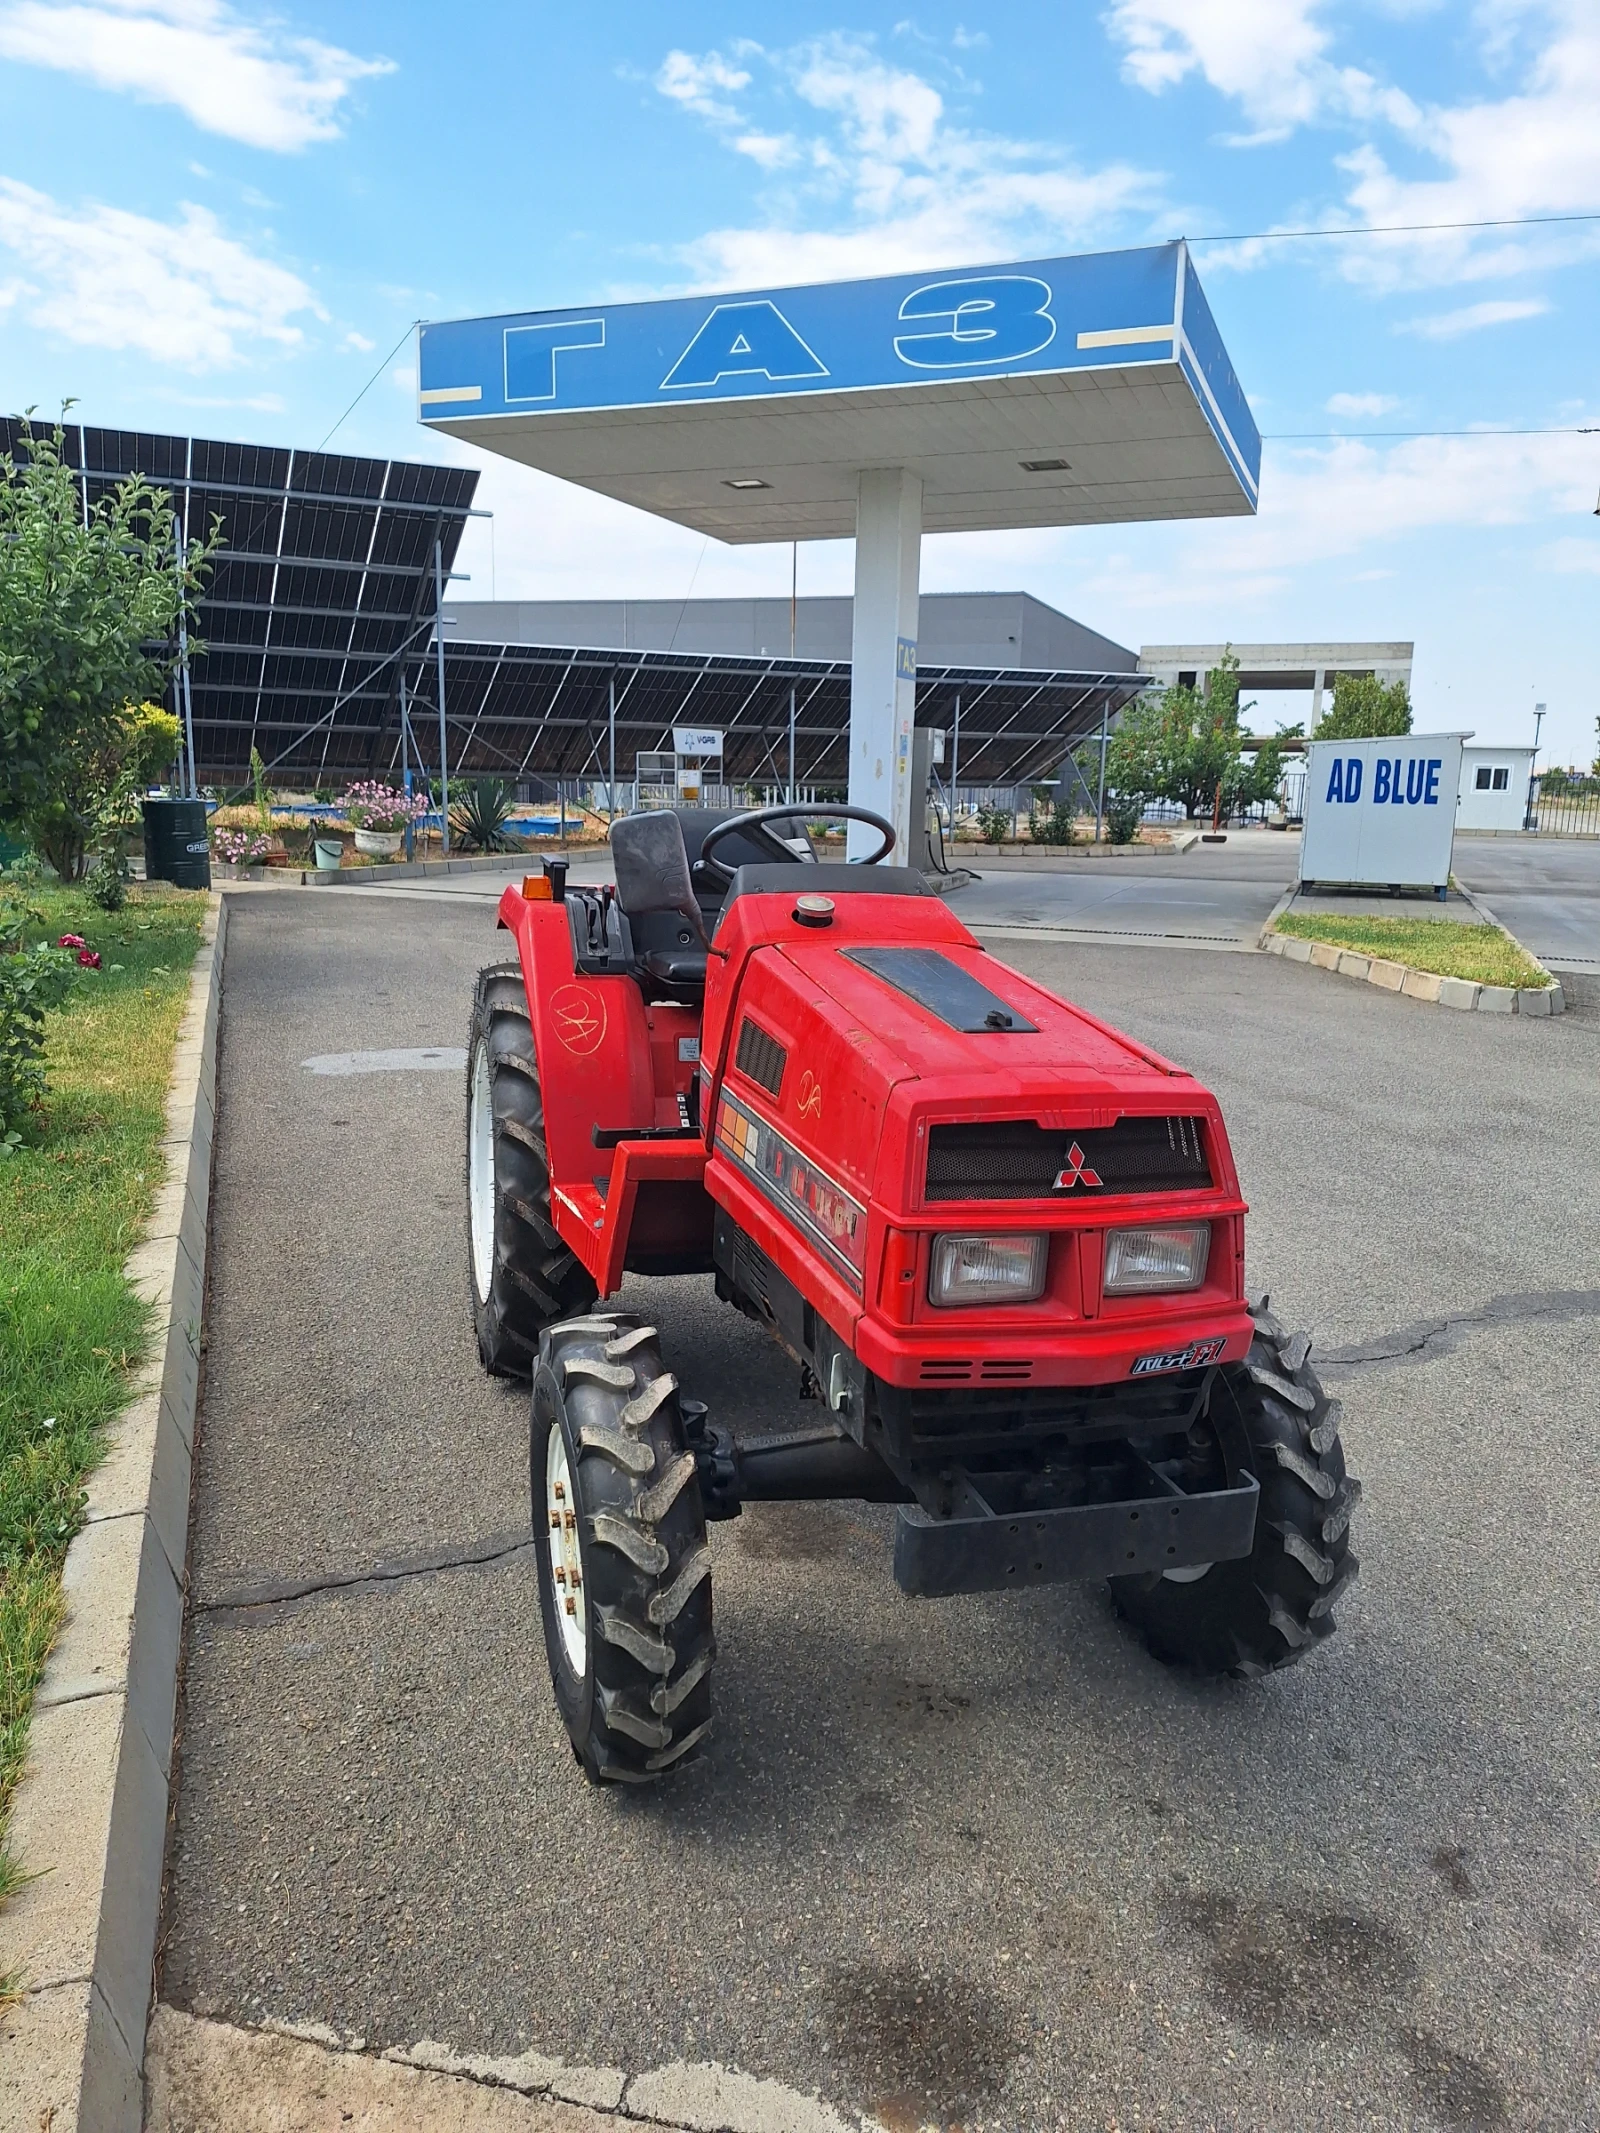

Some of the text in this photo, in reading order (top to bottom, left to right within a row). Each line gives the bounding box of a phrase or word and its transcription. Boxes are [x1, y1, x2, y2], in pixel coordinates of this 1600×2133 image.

[503, 275, 1055, 403] ГАЗ
[898, 642, 916, 674] ГАЗ
[1326, 758, 1442, 805] AD BLUE
